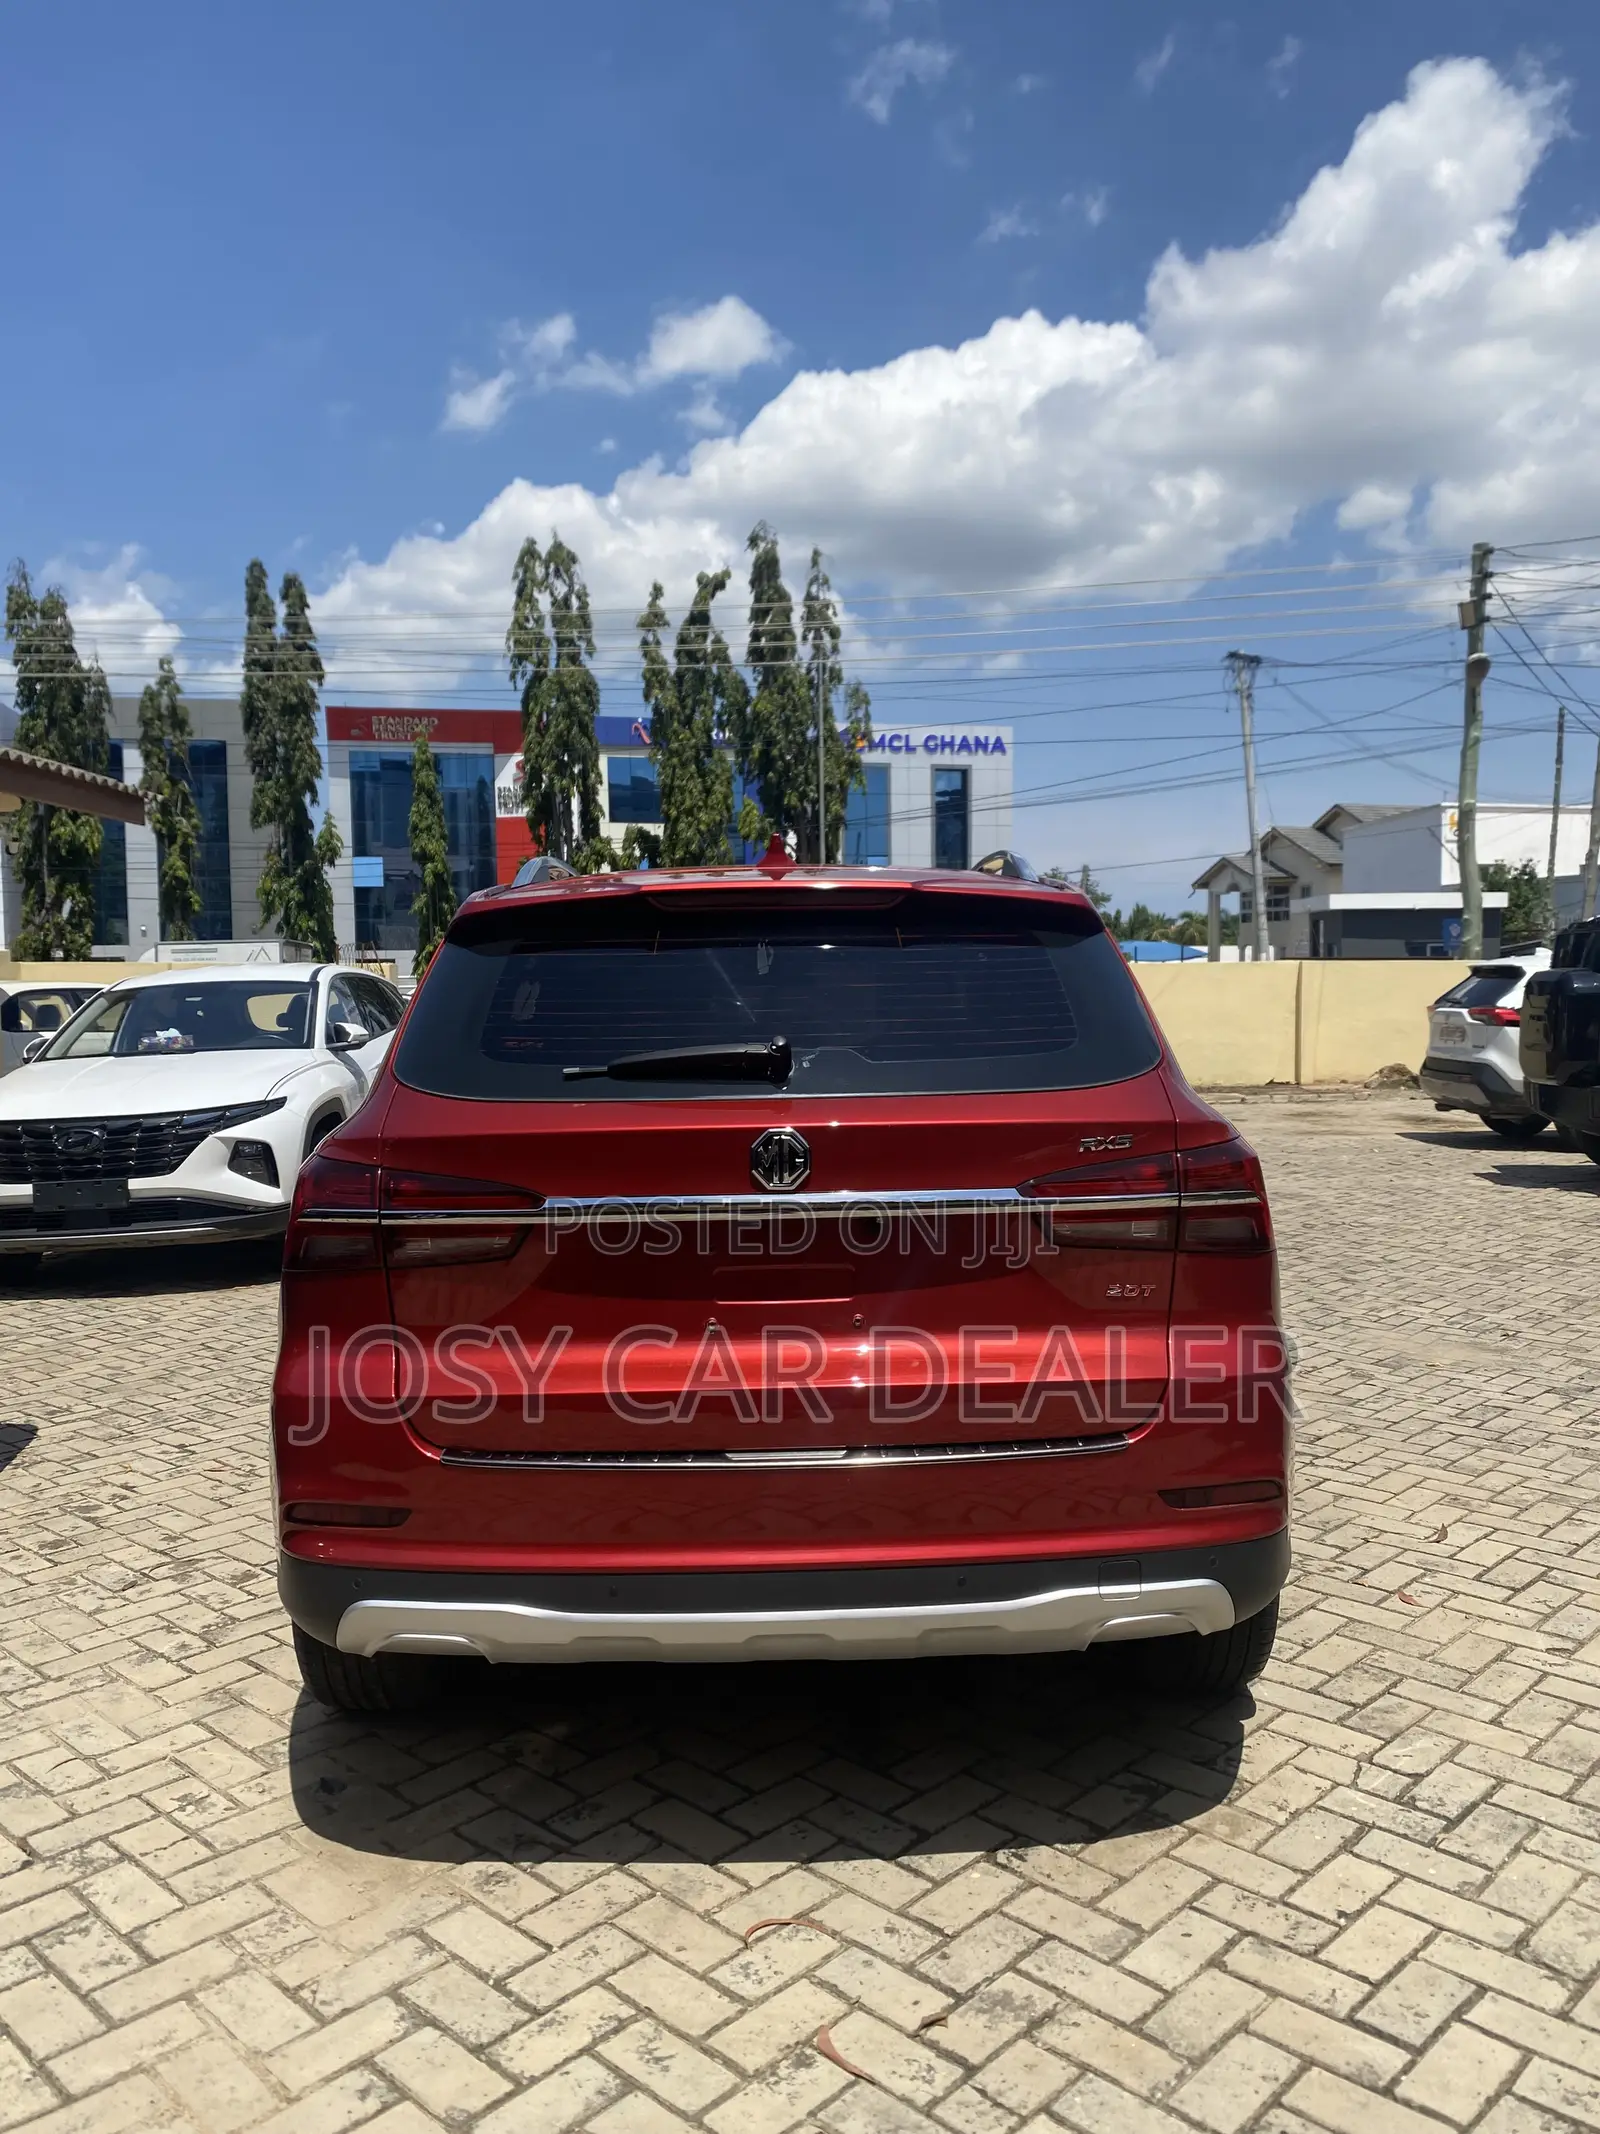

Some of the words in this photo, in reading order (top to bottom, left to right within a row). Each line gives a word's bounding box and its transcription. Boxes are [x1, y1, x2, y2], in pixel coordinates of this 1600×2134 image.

[371, 715, 438, 726] STANDARD
[373, 731, 412, 741] TRUST
[923, 734, 1007, 757] GHANA
[755, 1131, 807, 1187] MG
